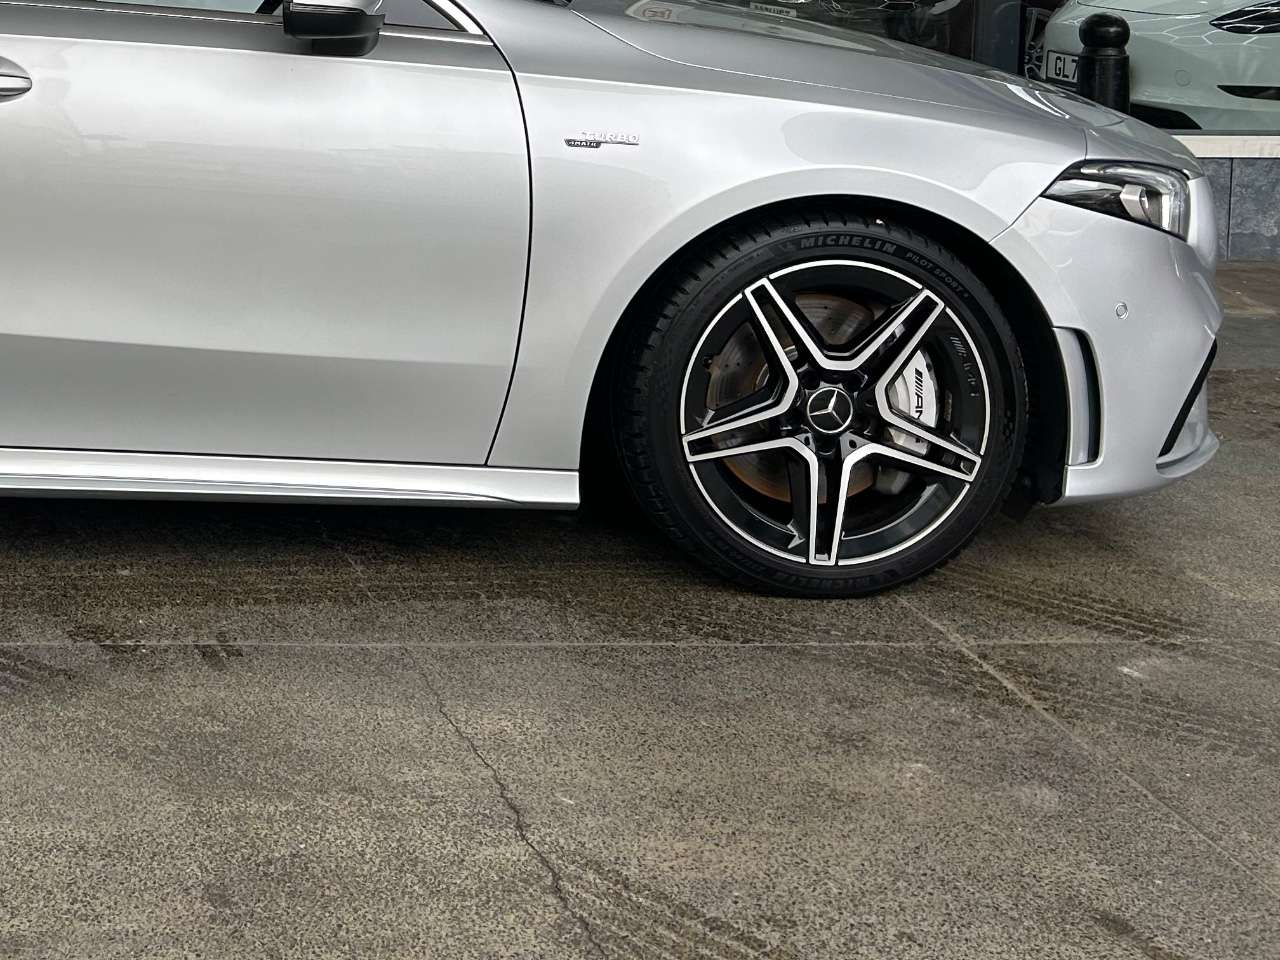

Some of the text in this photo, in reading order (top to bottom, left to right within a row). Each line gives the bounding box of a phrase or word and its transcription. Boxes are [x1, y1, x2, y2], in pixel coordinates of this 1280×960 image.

[800, 233, 965, 293] MICHELIN PILOT SPORT
